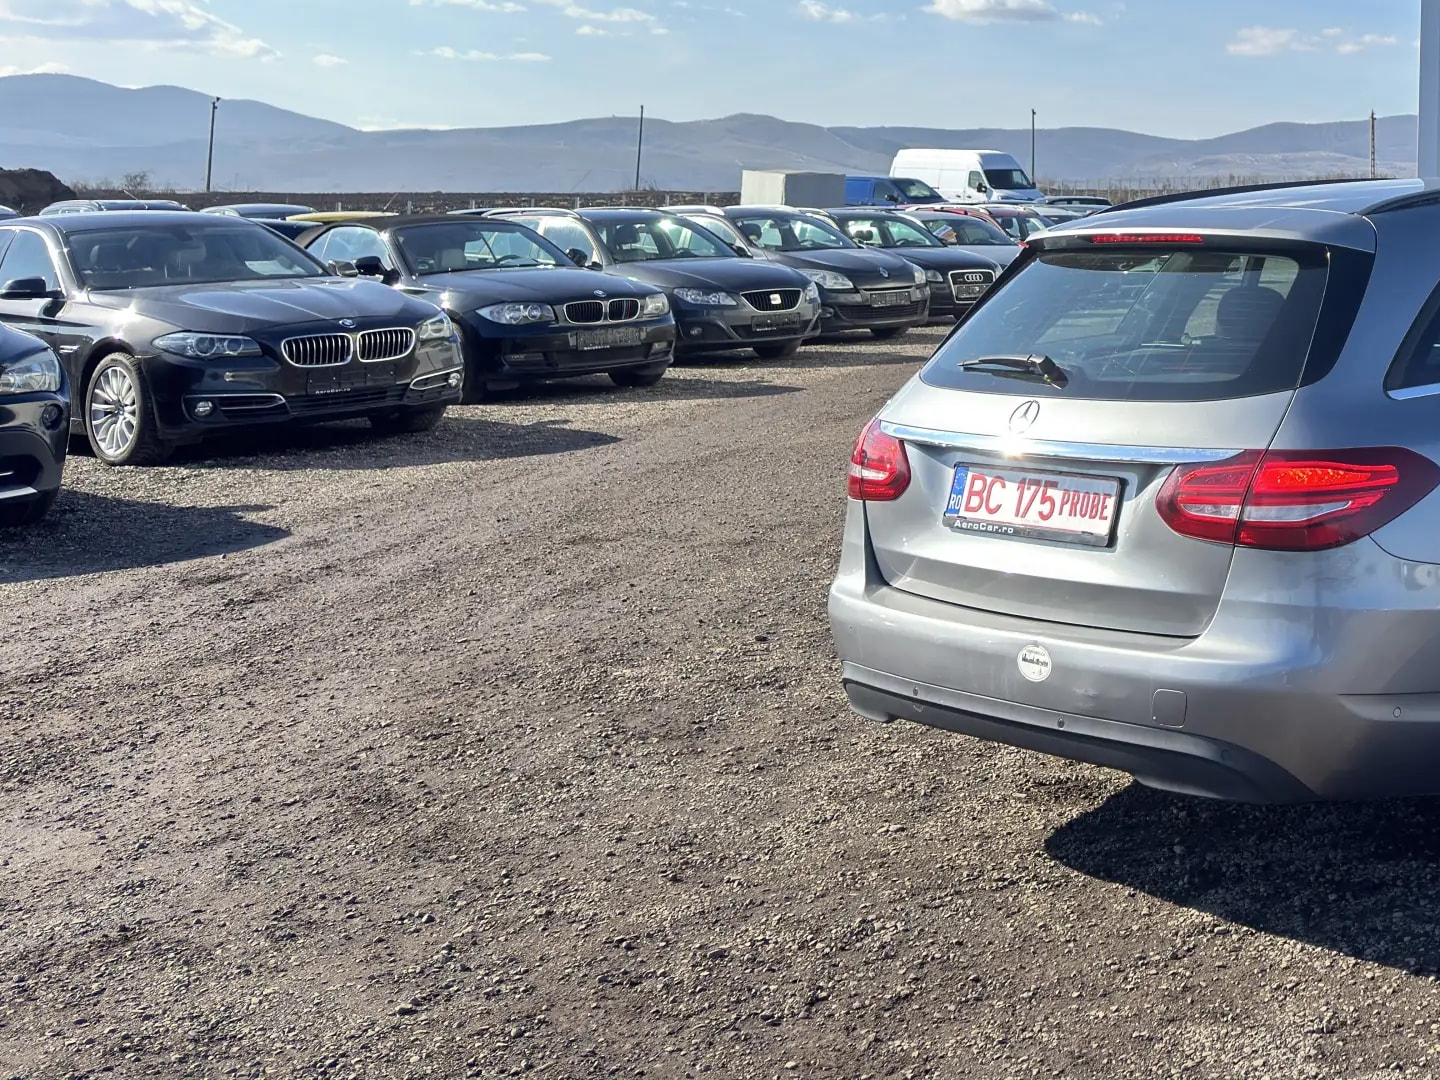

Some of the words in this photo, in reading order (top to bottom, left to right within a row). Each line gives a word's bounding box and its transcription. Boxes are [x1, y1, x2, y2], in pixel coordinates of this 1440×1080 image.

[949, 495, 962, 510] RO
[964, 473, 1006, 515] BC
[1014, 477, 1059, 521] 175
[1058, 489, 1112, 520] PROBE
[953, 519, 1014, 534] AeroCar.ro
